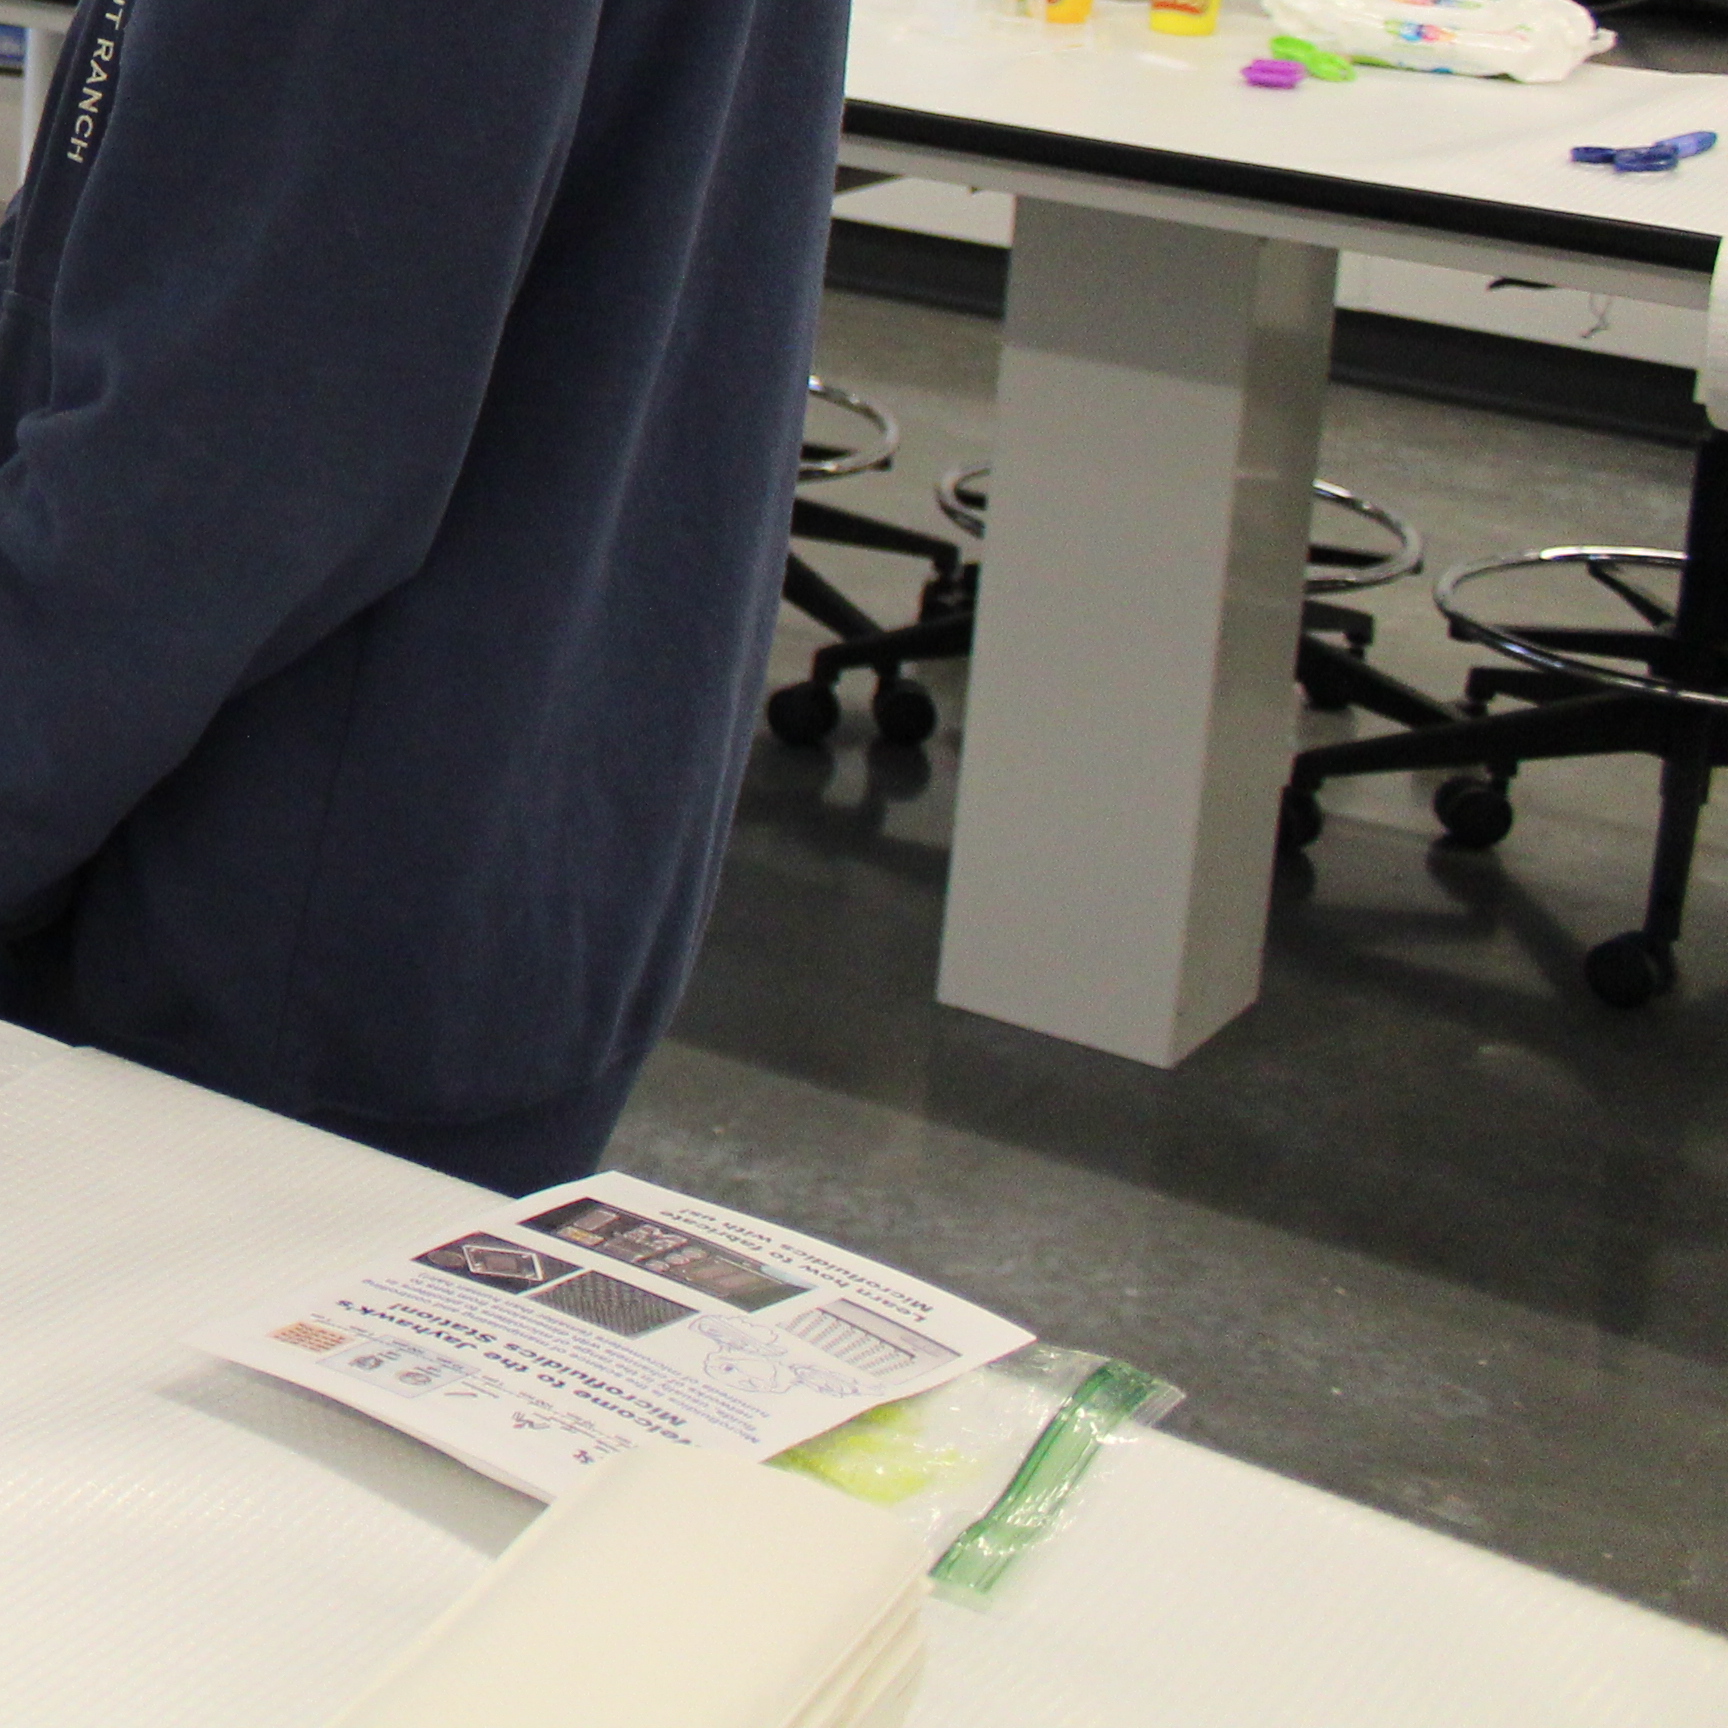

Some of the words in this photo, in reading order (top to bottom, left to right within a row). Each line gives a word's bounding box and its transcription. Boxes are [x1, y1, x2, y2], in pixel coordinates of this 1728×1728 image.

[67, 37, 115, 164] RANCH
[659, 1210, 762, 1251] fabricate
[678, 1208, 716, 1221] us!
[722, 1221, 772, 1243] with
[768, 1251, 793, 1264] to
[780, 1243, 932, 1312] Microfluidics
[798, 1264, 850, 1288] how
[855, 1287, 926, 1322] Learn
[338, 1300, 476, 1348] Jayhawk's
[388, 1303, 496, 1343] Station!
[483, 1351, 528, 1372] the
[503, 1342, 686, 1426] Microfluidics
[536, 1373, 566, 1388] to
